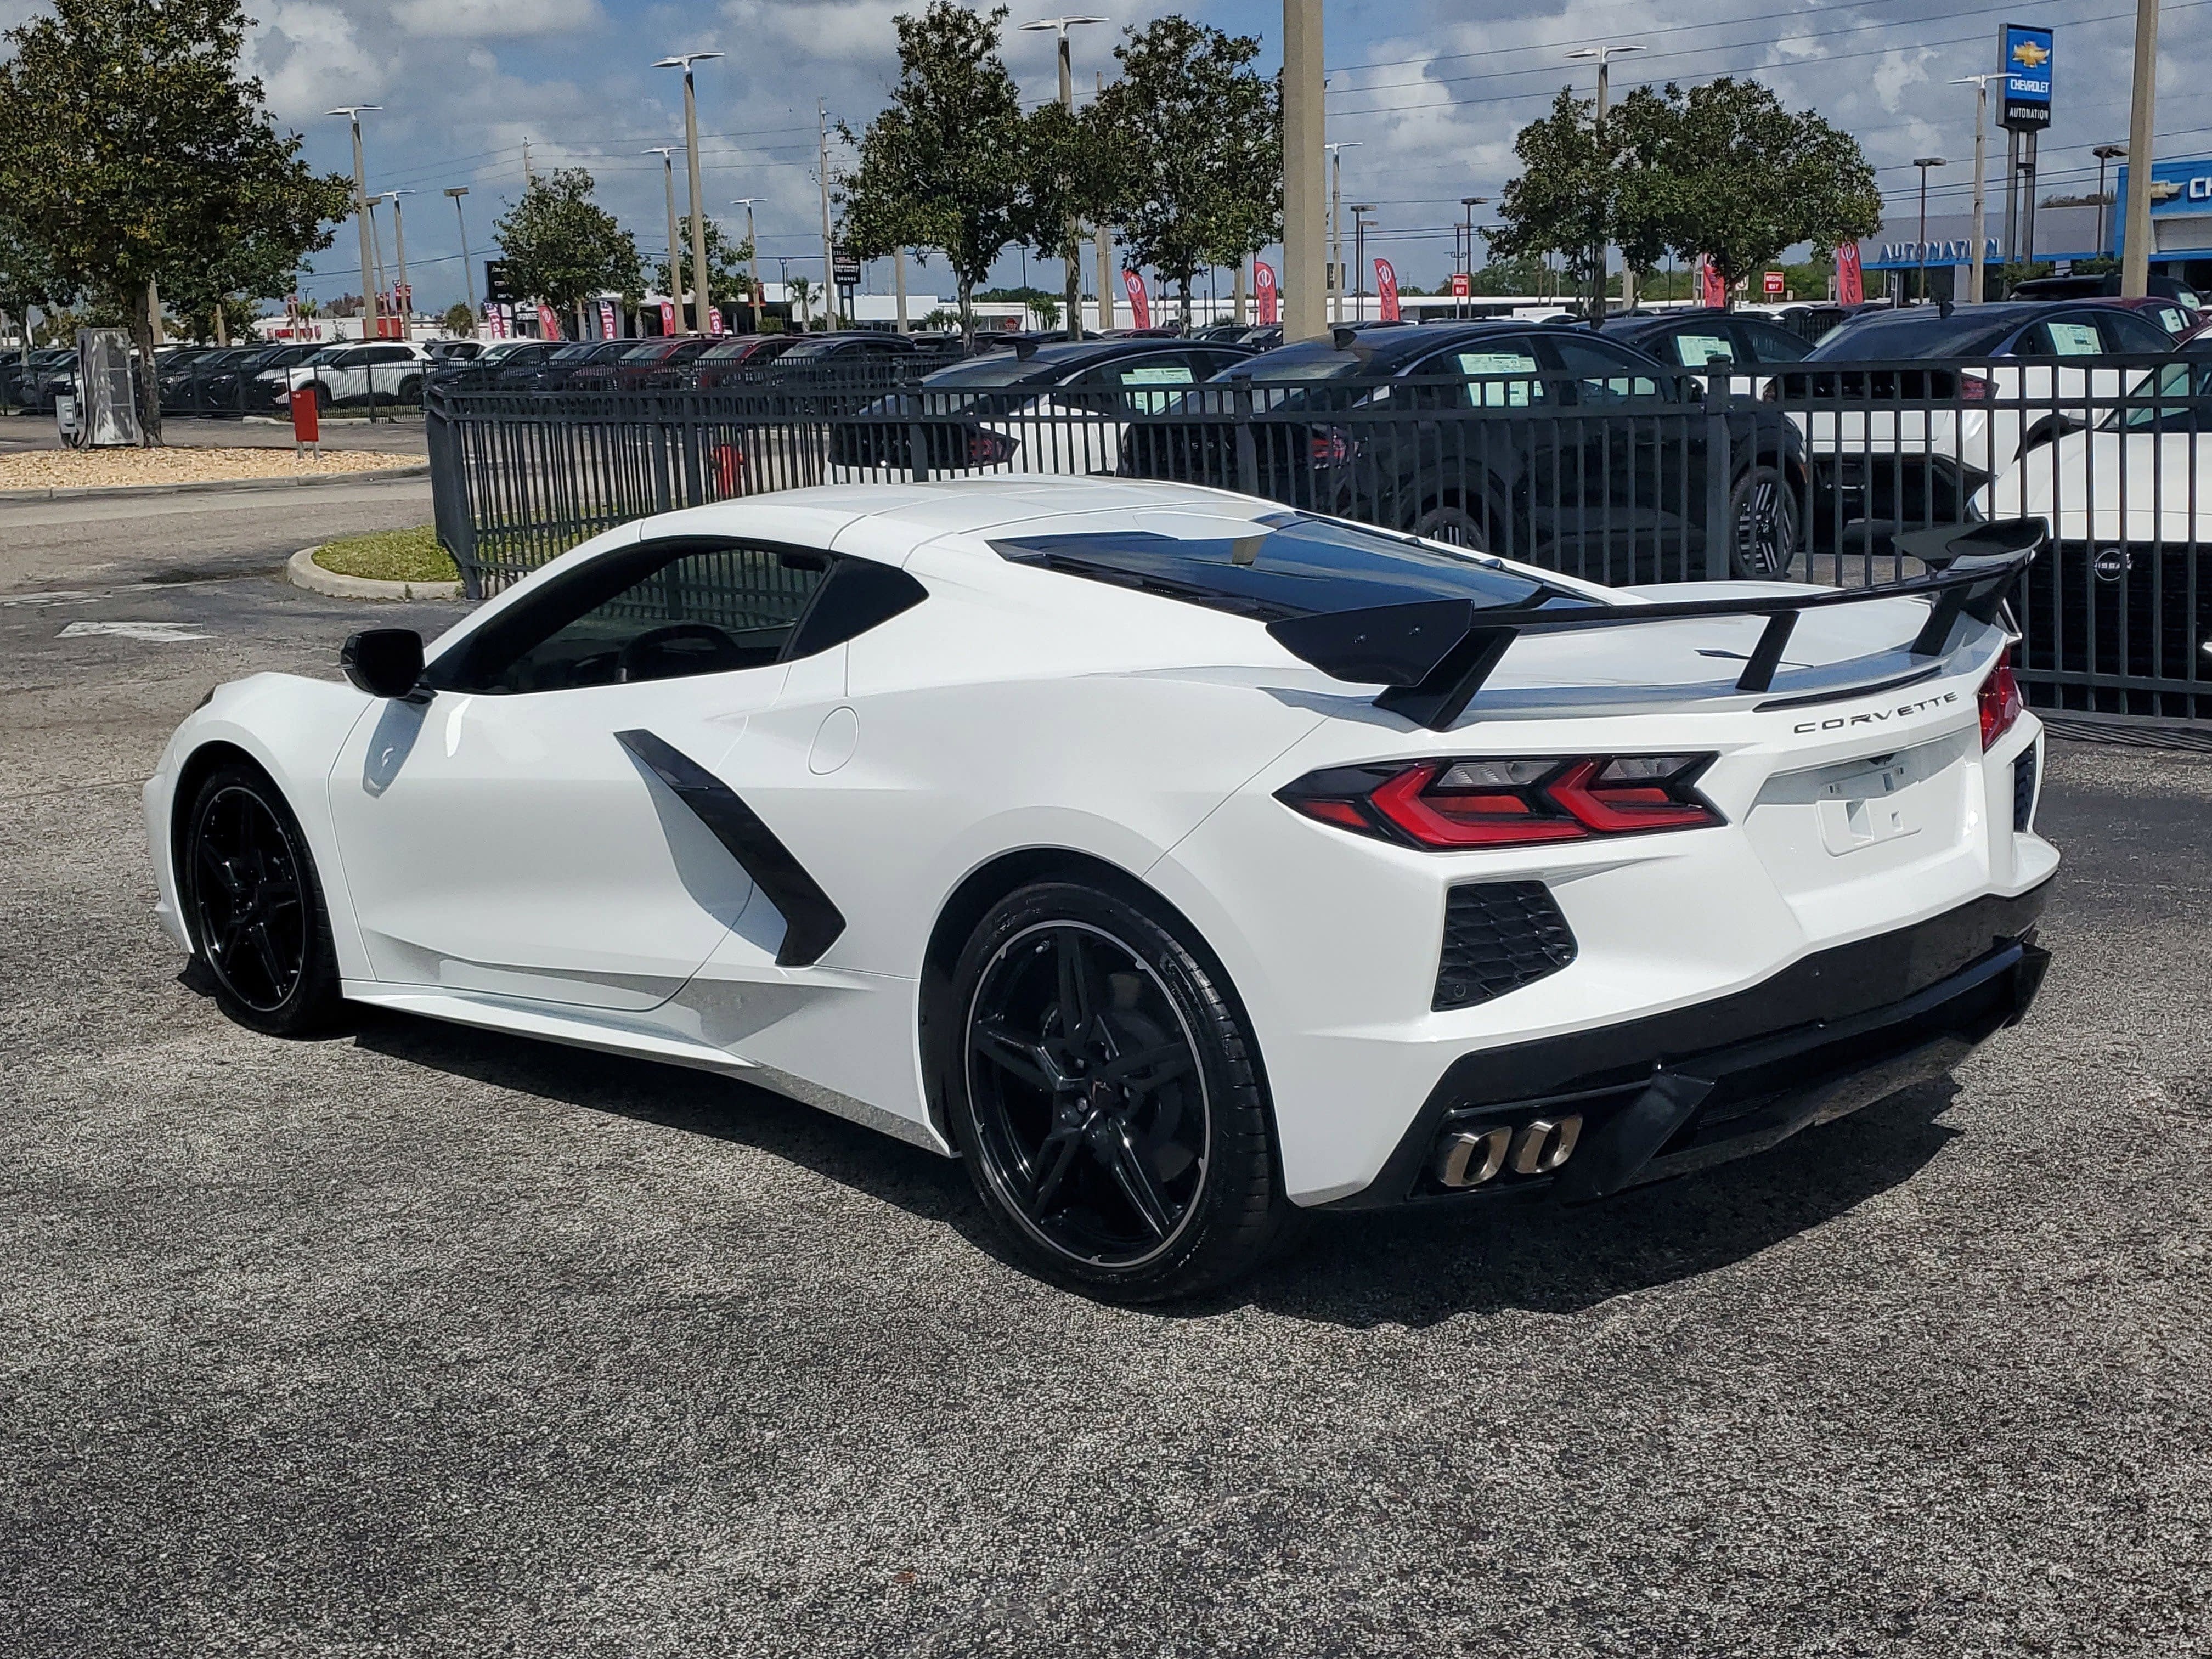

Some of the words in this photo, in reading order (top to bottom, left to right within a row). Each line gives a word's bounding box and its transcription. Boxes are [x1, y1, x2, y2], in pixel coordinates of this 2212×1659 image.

[2010, 78, 2050, 93] CHEVROLET
[2009, 107, 2049, 120] AUTONATION
[1878, 238, 2000, 264] AUTONATIN
[1794, 691, 1959, 734] CORVETTE
